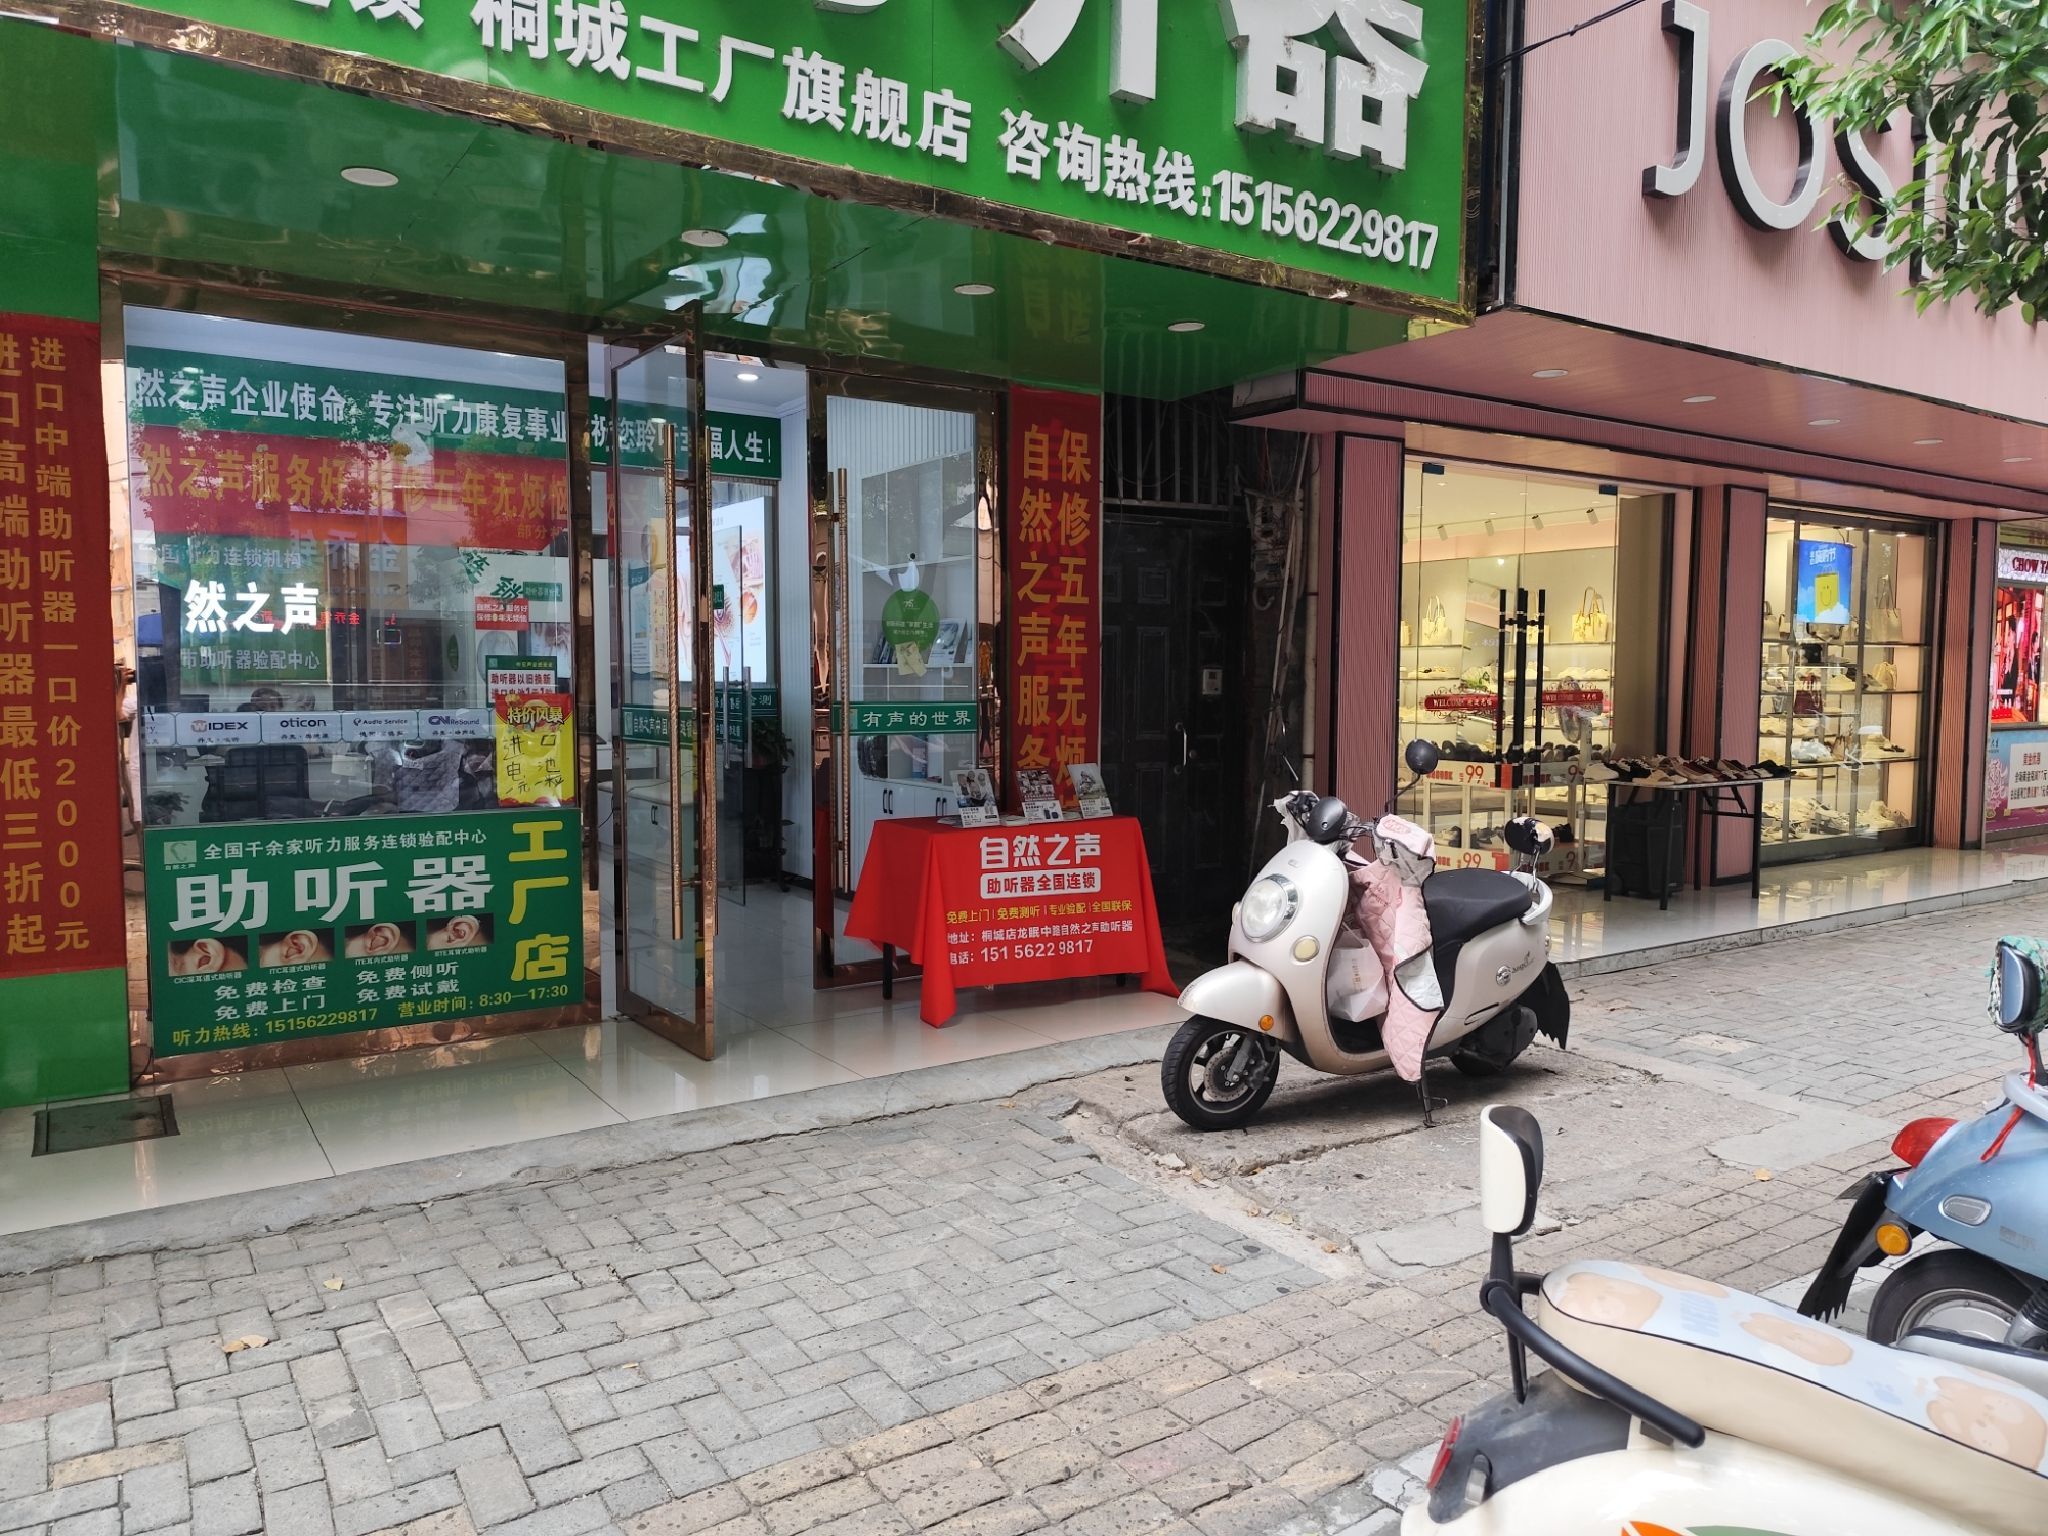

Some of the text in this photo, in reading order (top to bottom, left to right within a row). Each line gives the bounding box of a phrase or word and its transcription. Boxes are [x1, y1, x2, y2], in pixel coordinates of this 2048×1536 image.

[2012, 556, 2039, 573] CHOW
[183, 579, 320, 634] 然之声
[280, 717, 328, 728] oticon
[507, 705, 564, 726] 特价风暴
[862, 709, 972, 727] 有声的世界
[1465, 764, 1484, 784] 99
[203, 829, 488, 860] 全国千余家听力服务连锁验配中心
[980, 832, 1102, 870] 自然之声
[168, 853, 496, 934] 助听器
[986, 871, 1097, 895] 助听器全国连锁
[1058, 939, 1094, 956] 9817
[214, 976, 327, 1002] 免费检查
[214, 979, 460, 1022] 免费上门 免费试戴
